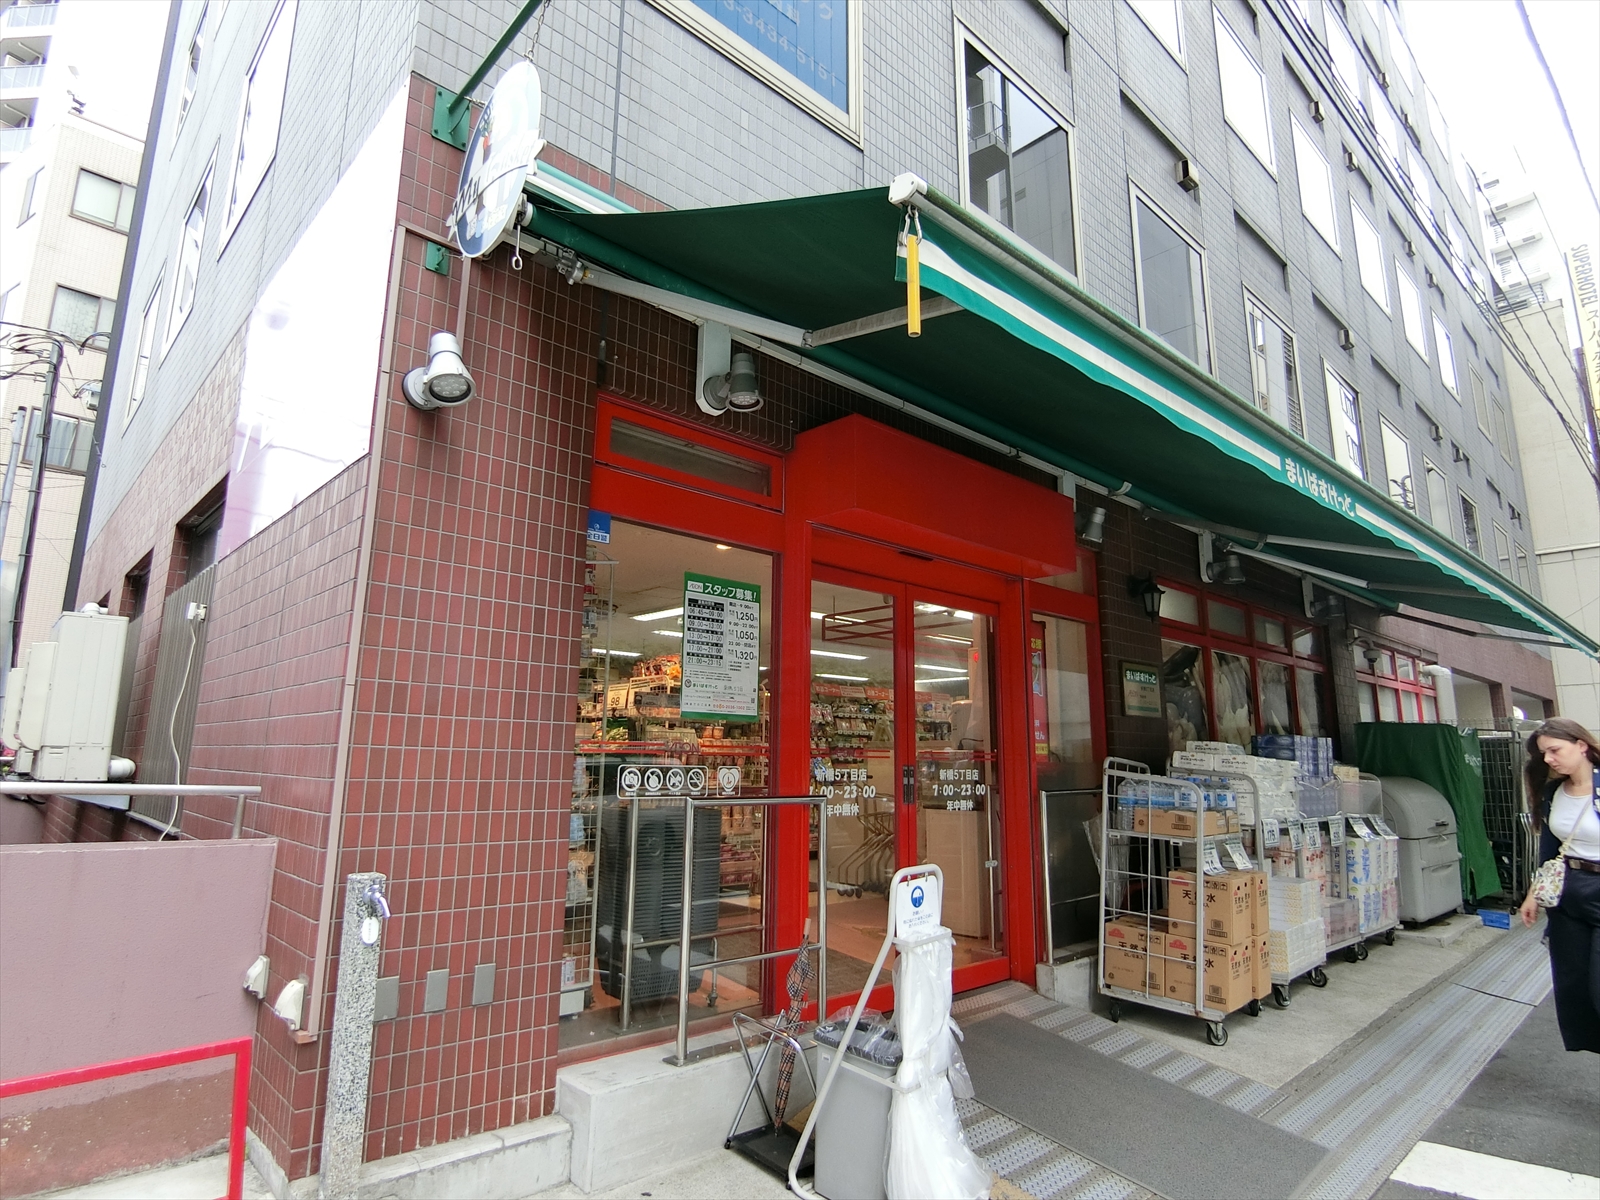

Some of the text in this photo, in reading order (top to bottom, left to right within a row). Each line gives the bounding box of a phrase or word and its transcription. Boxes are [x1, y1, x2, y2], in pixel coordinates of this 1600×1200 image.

[1571, 243, 1599, 308] SUPERHOTEL
[1285, 457, 1355, 518] まいばすけっと
[816, 768, 868, 782] 新橋5丁目店
[939, 768, 979, 781] 新橋5丁目店
[932, 784, 986, 797] 7:00~23:00
[1182, 889, 1216, 904] 天水
